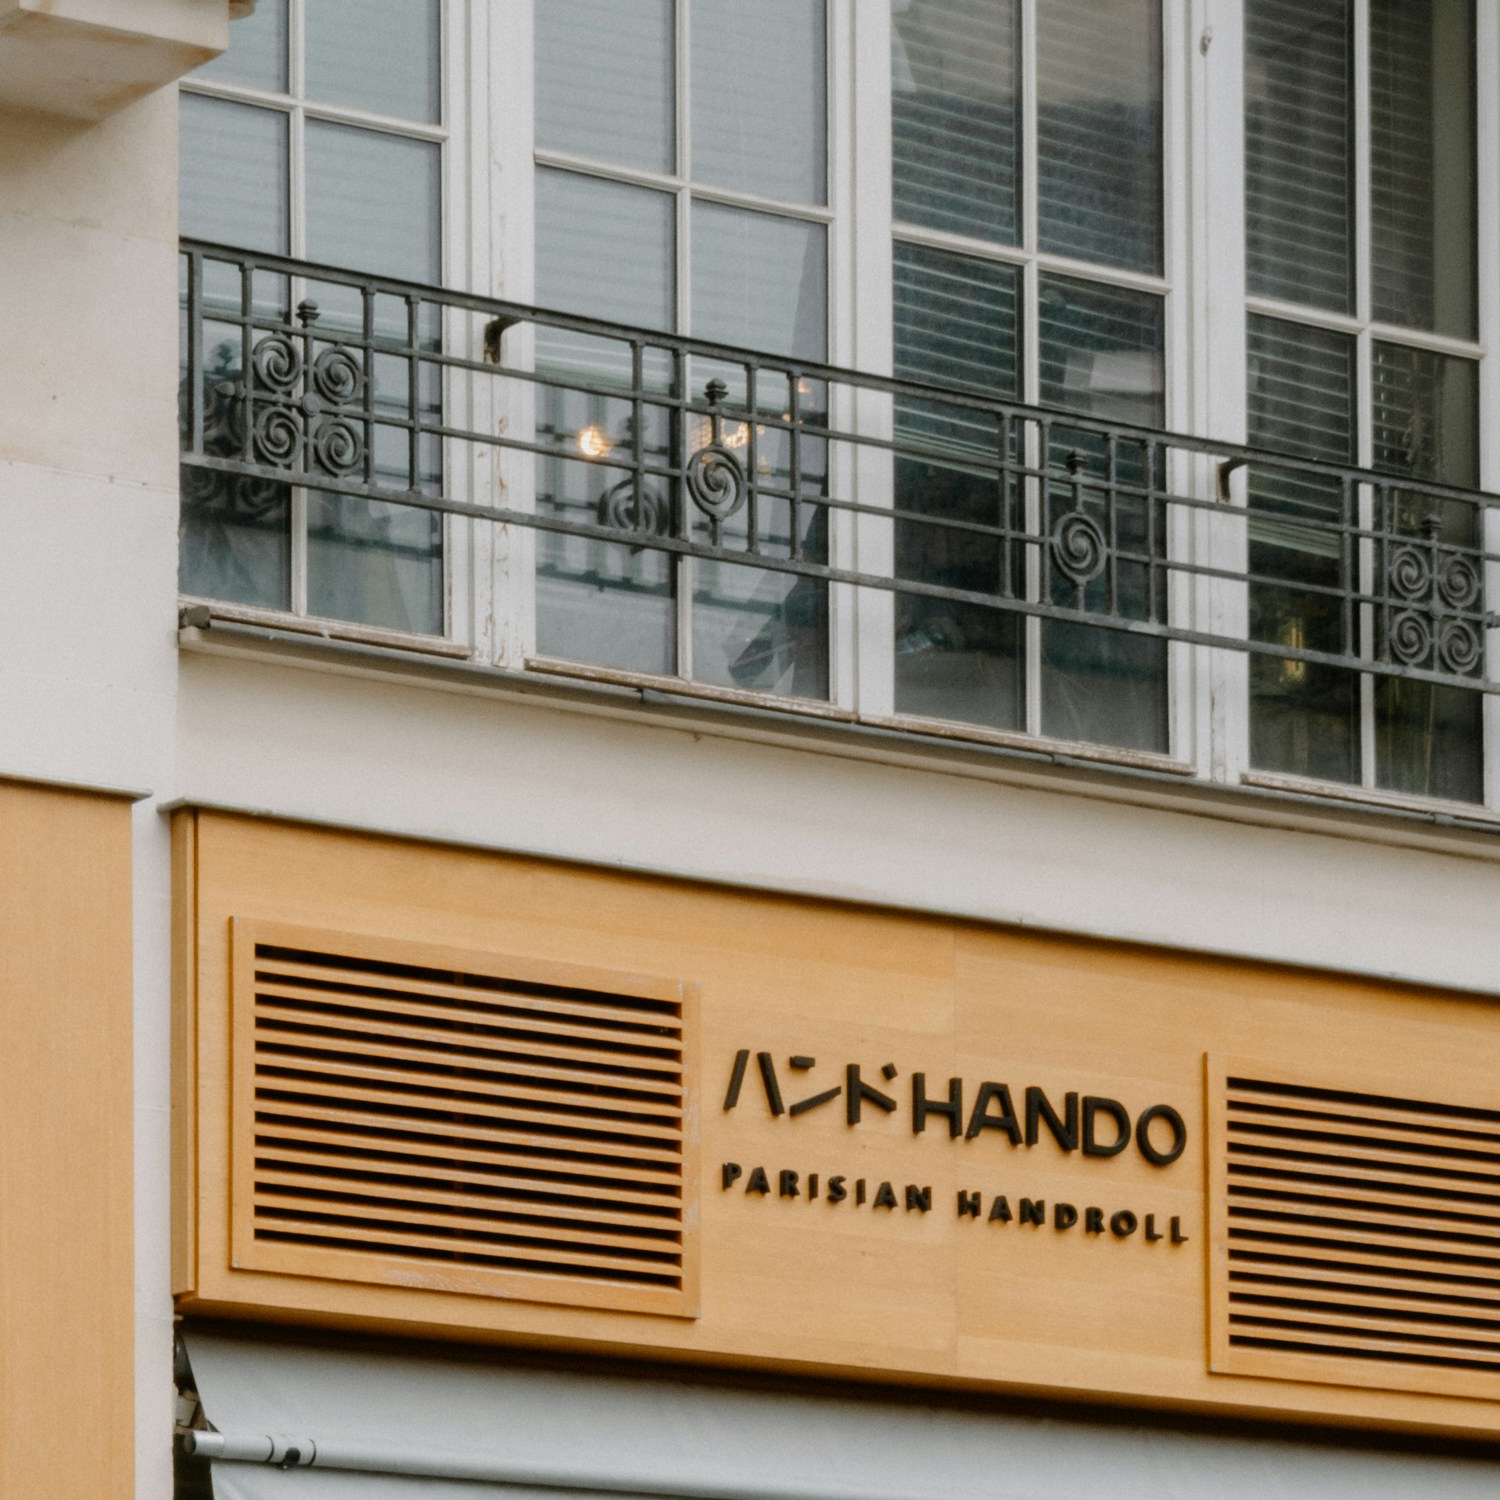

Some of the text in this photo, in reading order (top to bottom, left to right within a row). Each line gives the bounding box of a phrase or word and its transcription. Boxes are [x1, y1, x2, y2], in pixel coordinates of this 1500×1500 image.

[912, 1071, 1187, 1167] HANDO
[722, 1161, 1189, 1244] PARISIAN HANDROLL
